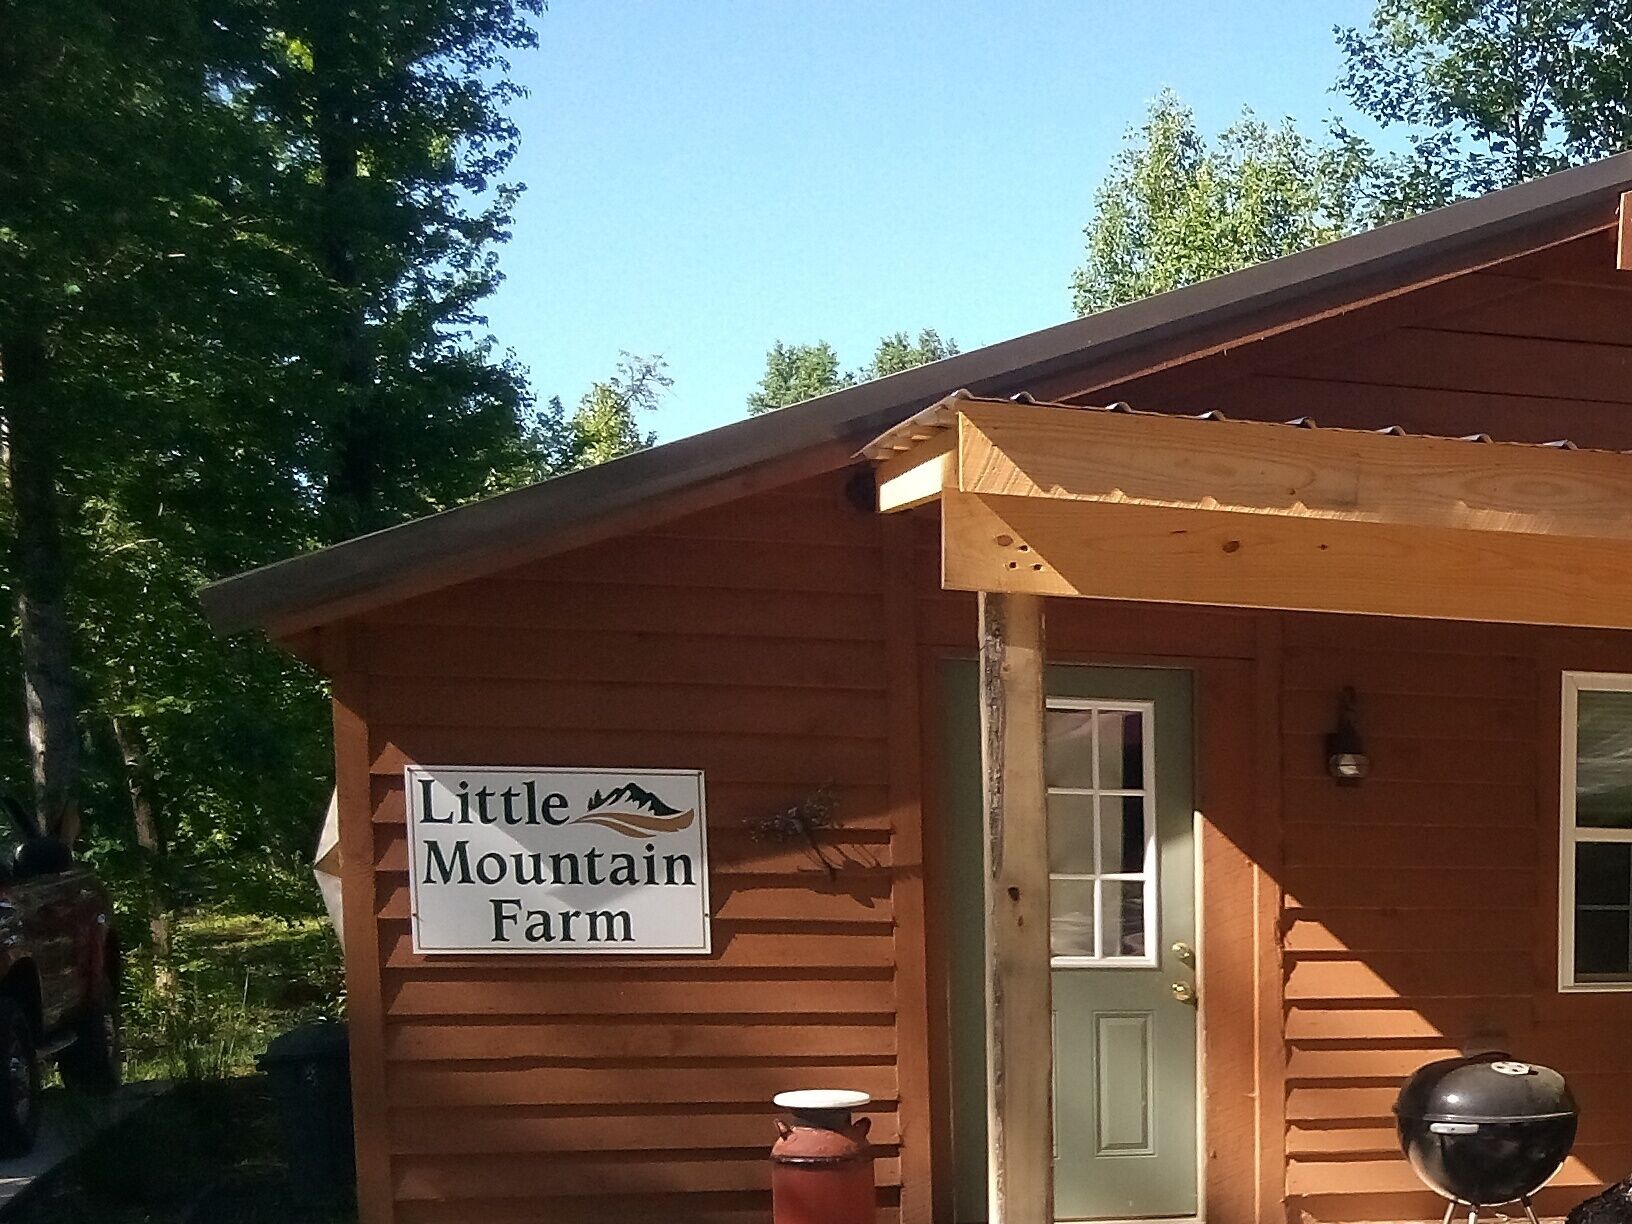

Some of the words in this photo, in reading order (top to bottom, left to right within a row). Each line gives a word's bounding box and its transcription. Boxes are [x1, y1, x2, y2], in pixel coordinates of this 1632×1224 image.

[418, 779, 570, 826] Little
[422, 839, 697, 886] Mountain
[488, 898, 637, 943] Farm
